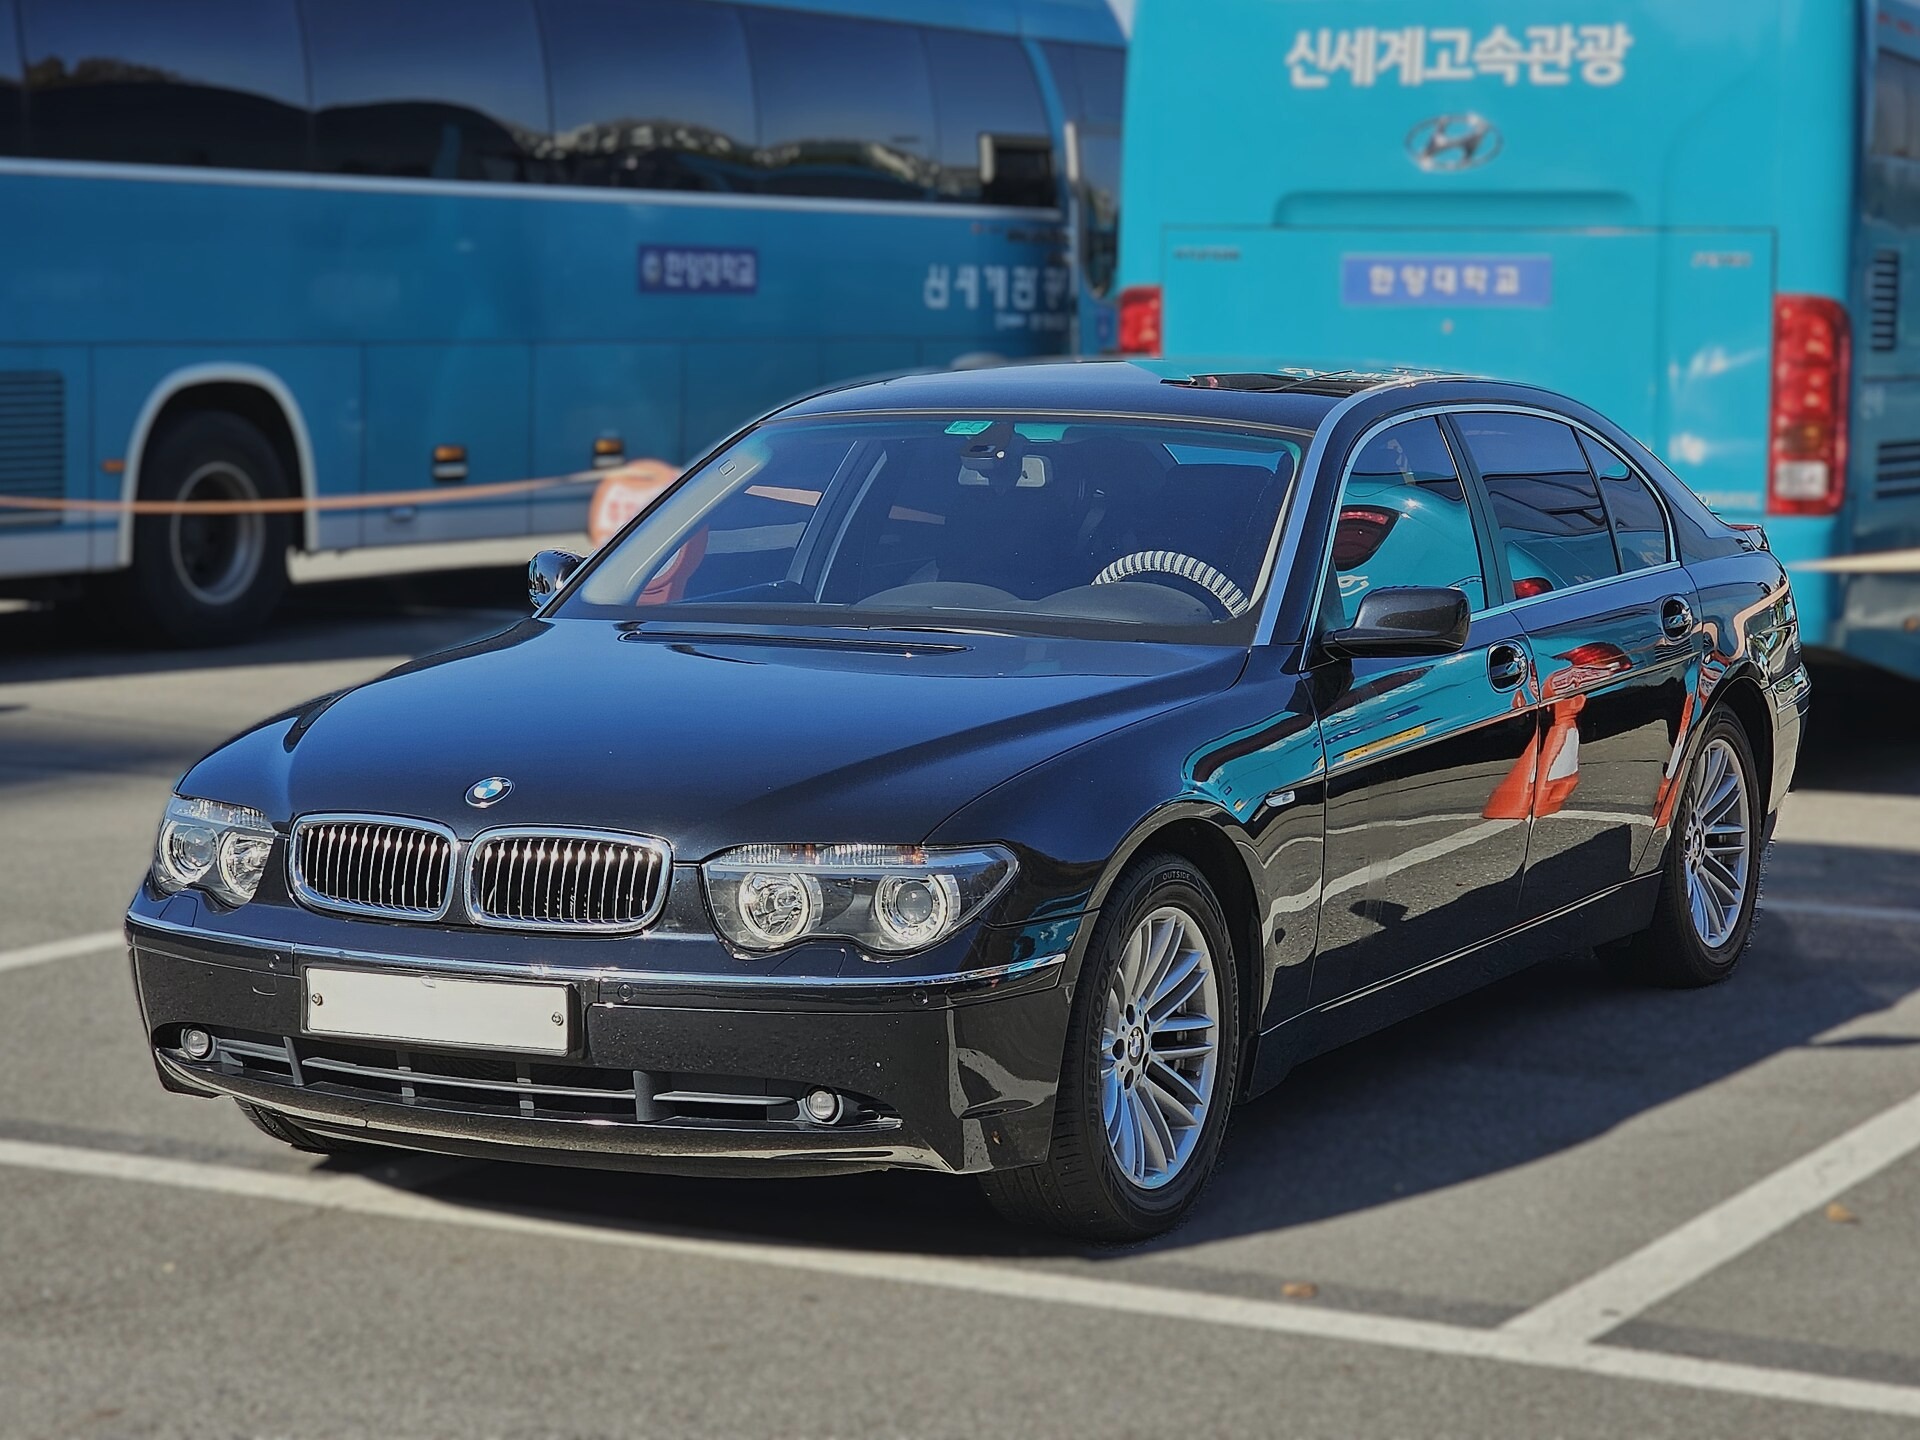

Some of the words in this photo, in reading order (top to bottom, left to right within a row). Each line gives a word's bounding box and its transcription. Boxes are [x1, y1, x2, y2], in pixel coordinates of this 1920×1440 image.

[1285, 23, 1633, 88] 신세계고속관광
[1369, 265, 1519, 297] 한양대학교
[1162, 870, 1191, 881] OUTSIDE
